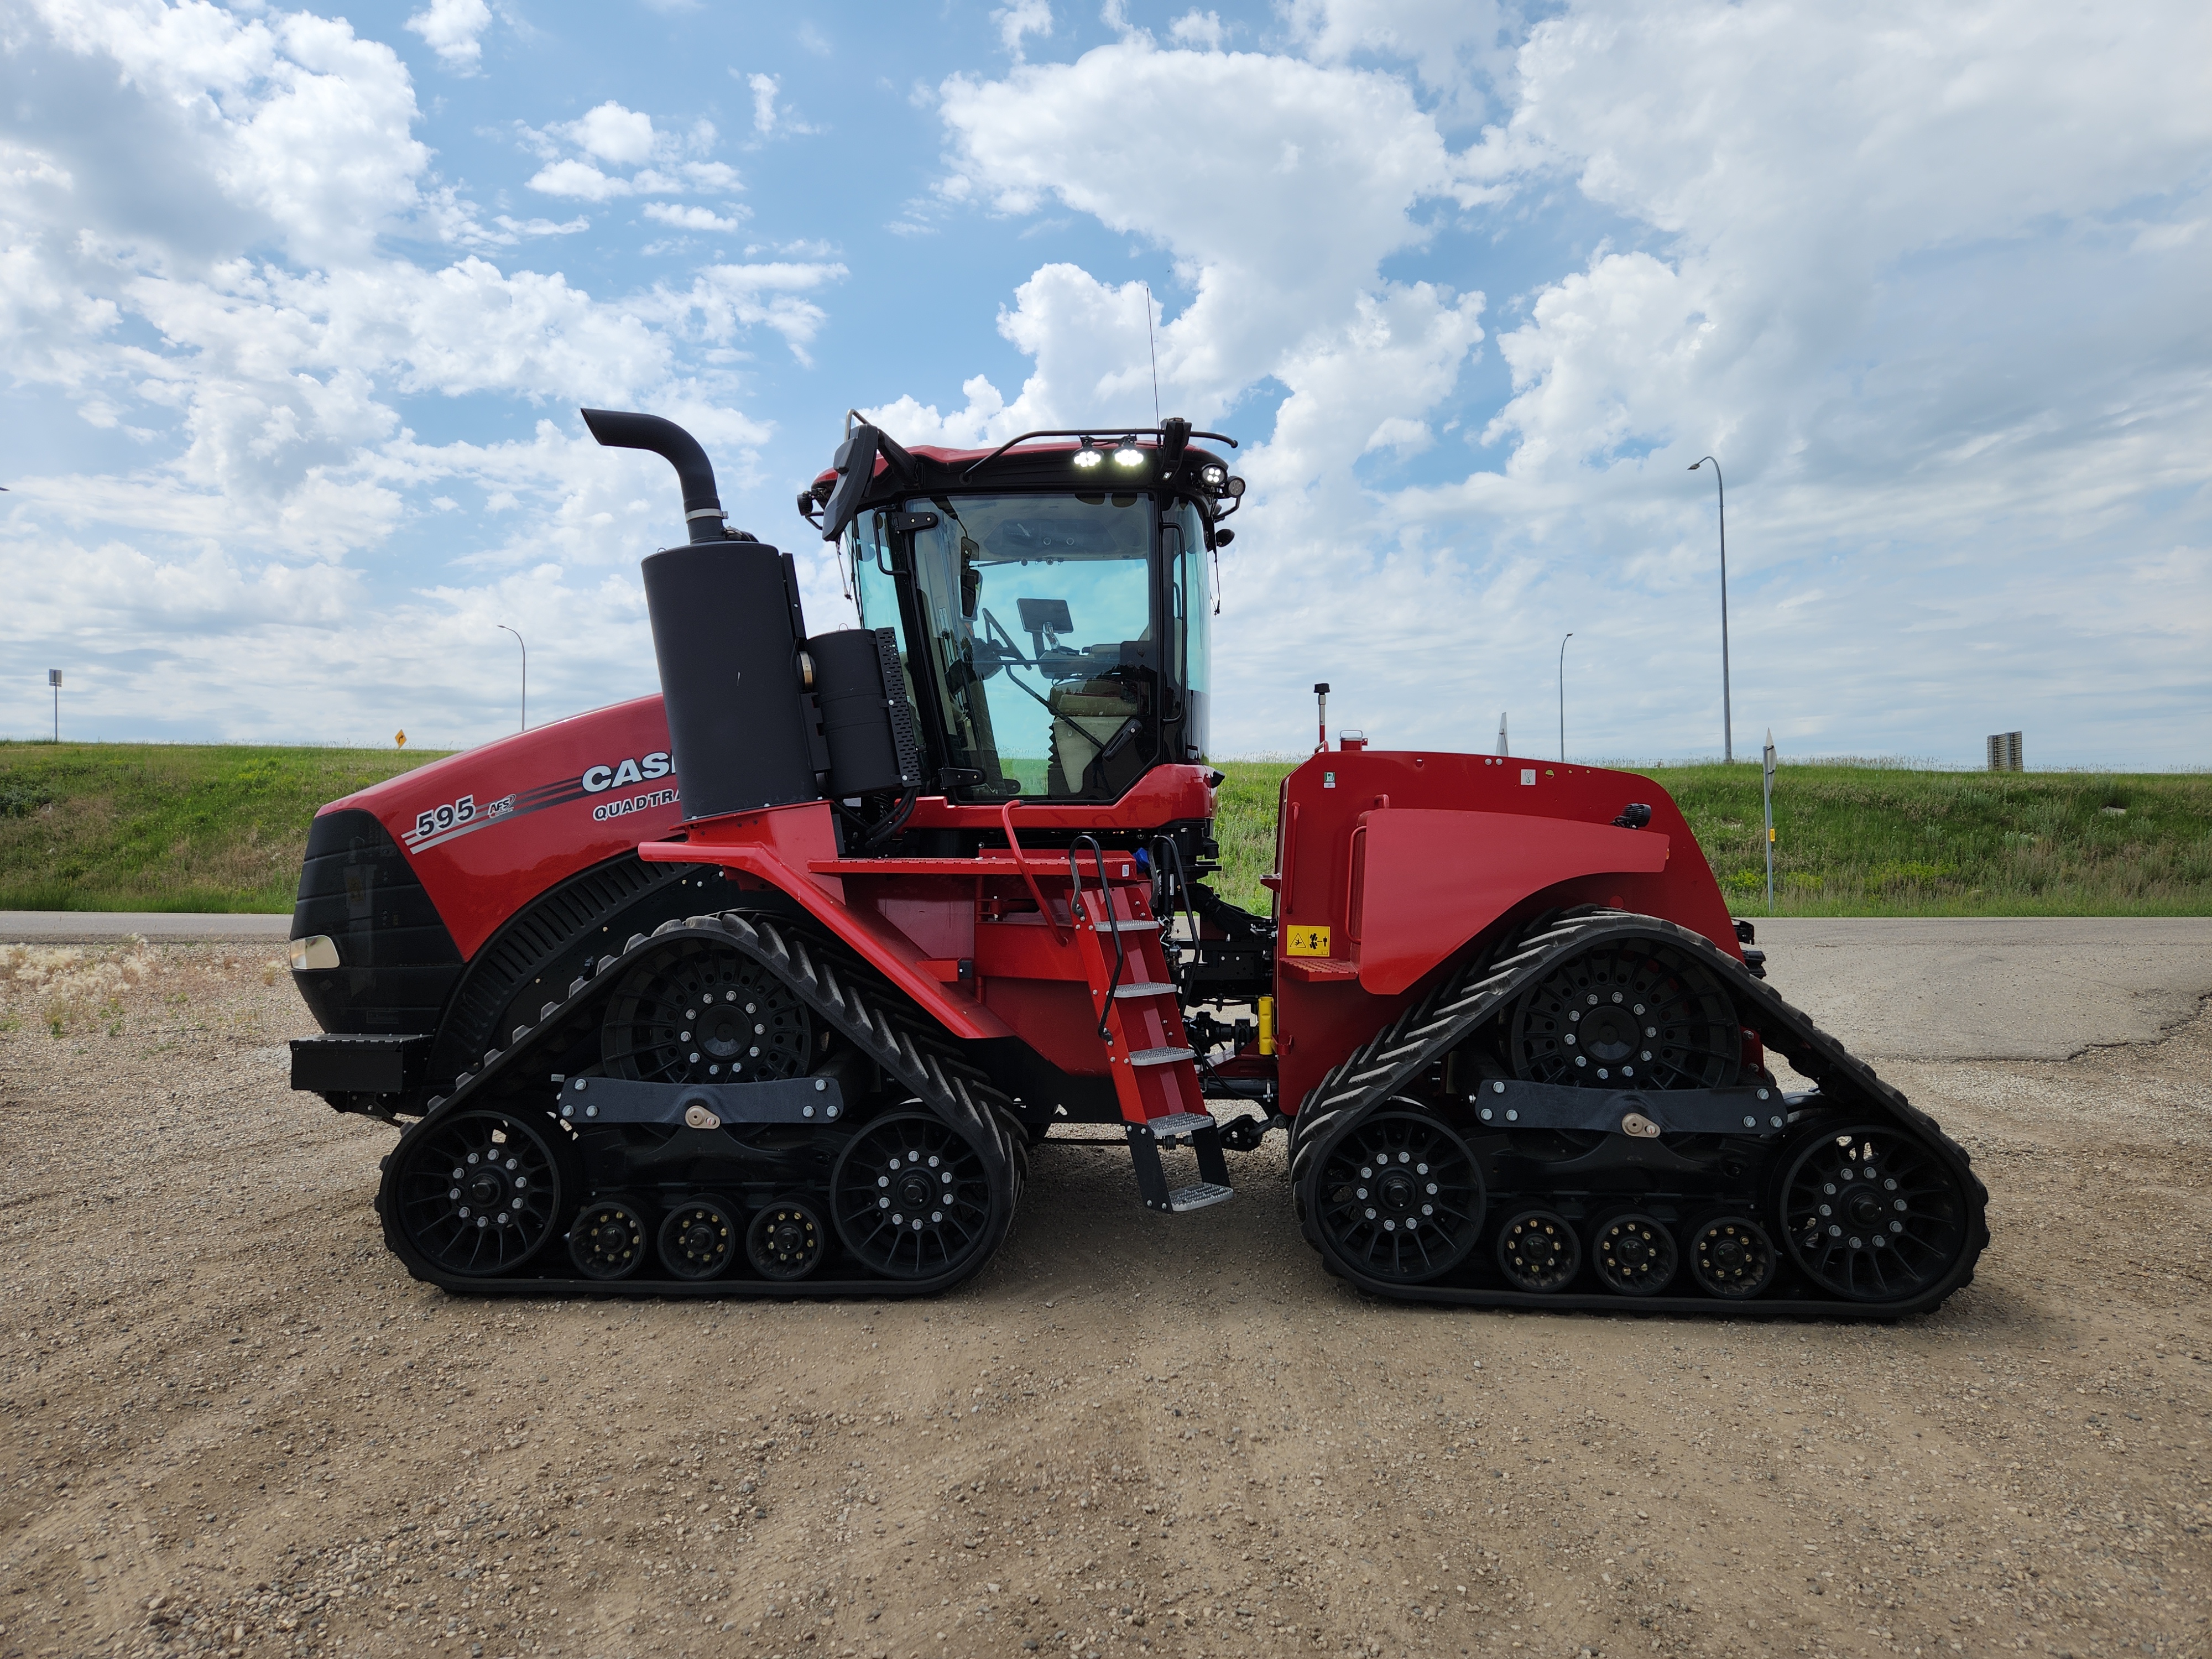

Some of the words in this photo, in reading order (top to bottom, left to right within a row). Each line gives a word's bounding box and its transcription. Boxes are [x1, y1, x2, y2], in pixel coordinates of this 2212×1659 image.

[582, 752, 676, 792] CAS
[416, 795, 476, 837] 595
[488, 798, 510, 815] AFS
[593, 789, 680, 821] QUADTR
